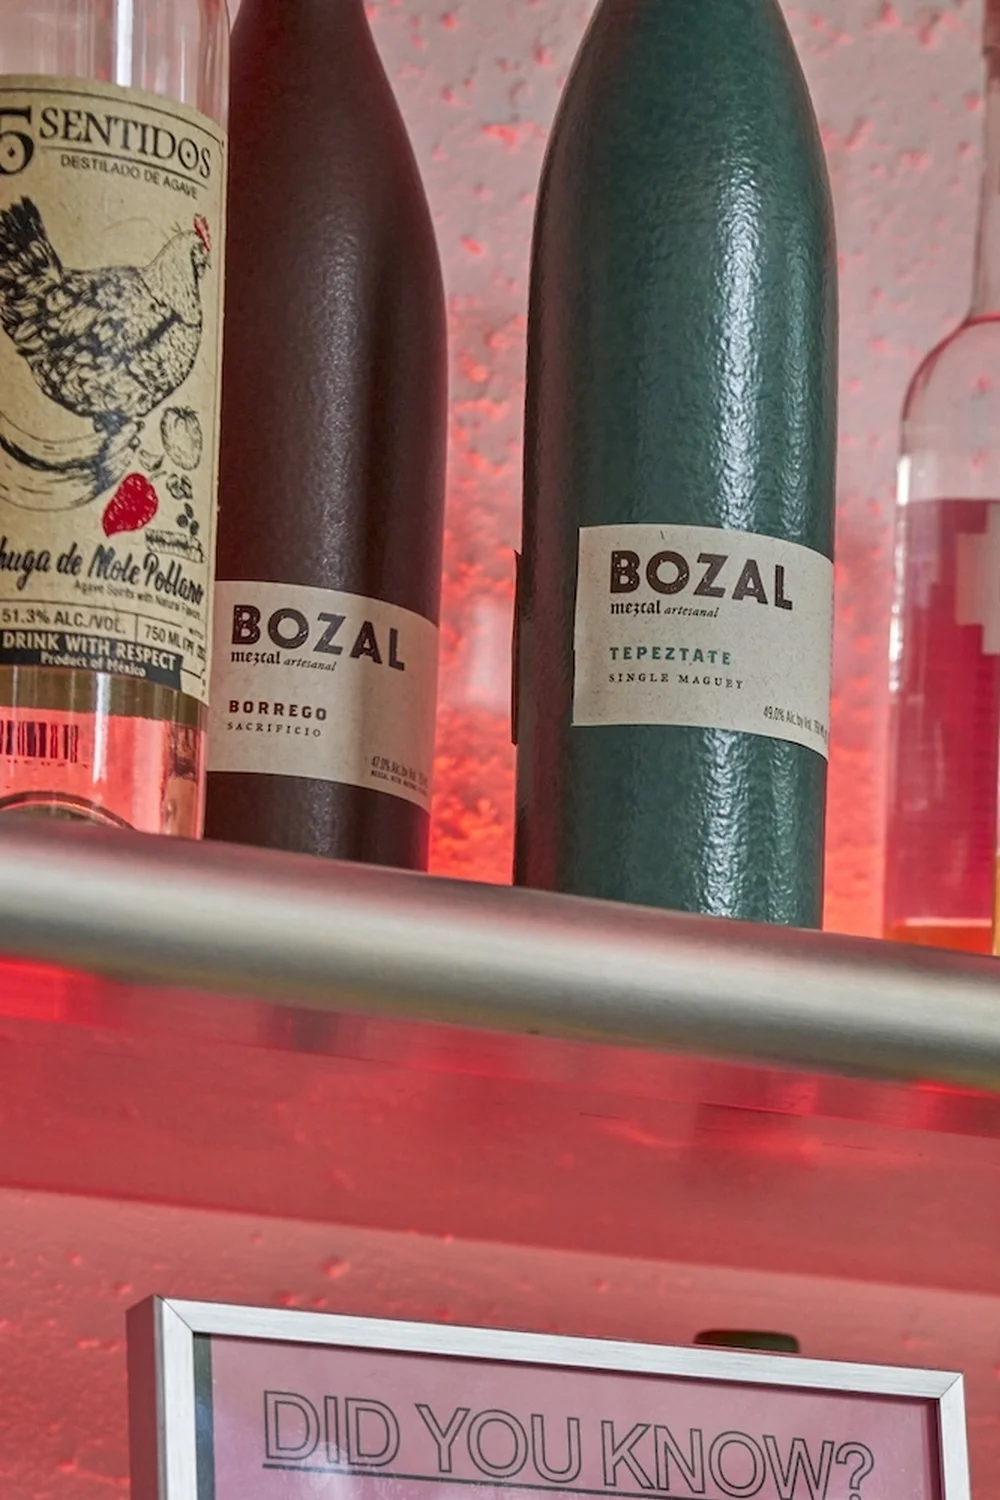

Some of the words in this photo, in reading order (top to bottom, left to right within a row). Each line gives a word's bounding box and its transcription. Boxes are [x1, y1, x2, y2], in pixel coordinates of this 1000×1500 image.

[0, 106, 35, 177] 5
[39, 106, 211, 180] SENTIDOS
[60, 153, 141, 181] DESTILADO
[144, 170, 160, 185] DE
[163, 176, 199, 201] AGAVE
[56, 541, 83, 578] de
[88, 543, 140, 586] Mole
[609, 549, 793, 611] BOZAL
[610, 599, 661, 617] mezcal
[2, 609, 51, 625] 51.3%
[54, 609, 127, 635] ALC./VOL.
[144, 624, 167, 644] 750
[232, 603, 407, 673] BOZAL
[3, 630, 61, 651] DRINK
[65, 634, 111, 656] WITH
[116, 642, 177, 672] RESPECT
[40, 652, 87, 669] Product
[90, 656, 104, 670] of
[230, 648, 281, 674] mezcal
[609, 646, 733, 666] TEPEZTATE
[608, 672, 670, 684] SINGLE
[678, 674, 744, 690] MAGUEY
[228, 698, 328, 723] BORREGO
[226, 721, 323, 739] SACRIFICIO
[263, 1389, 401, 1468] DID
[414, 1402, 582, 1484] YOU
